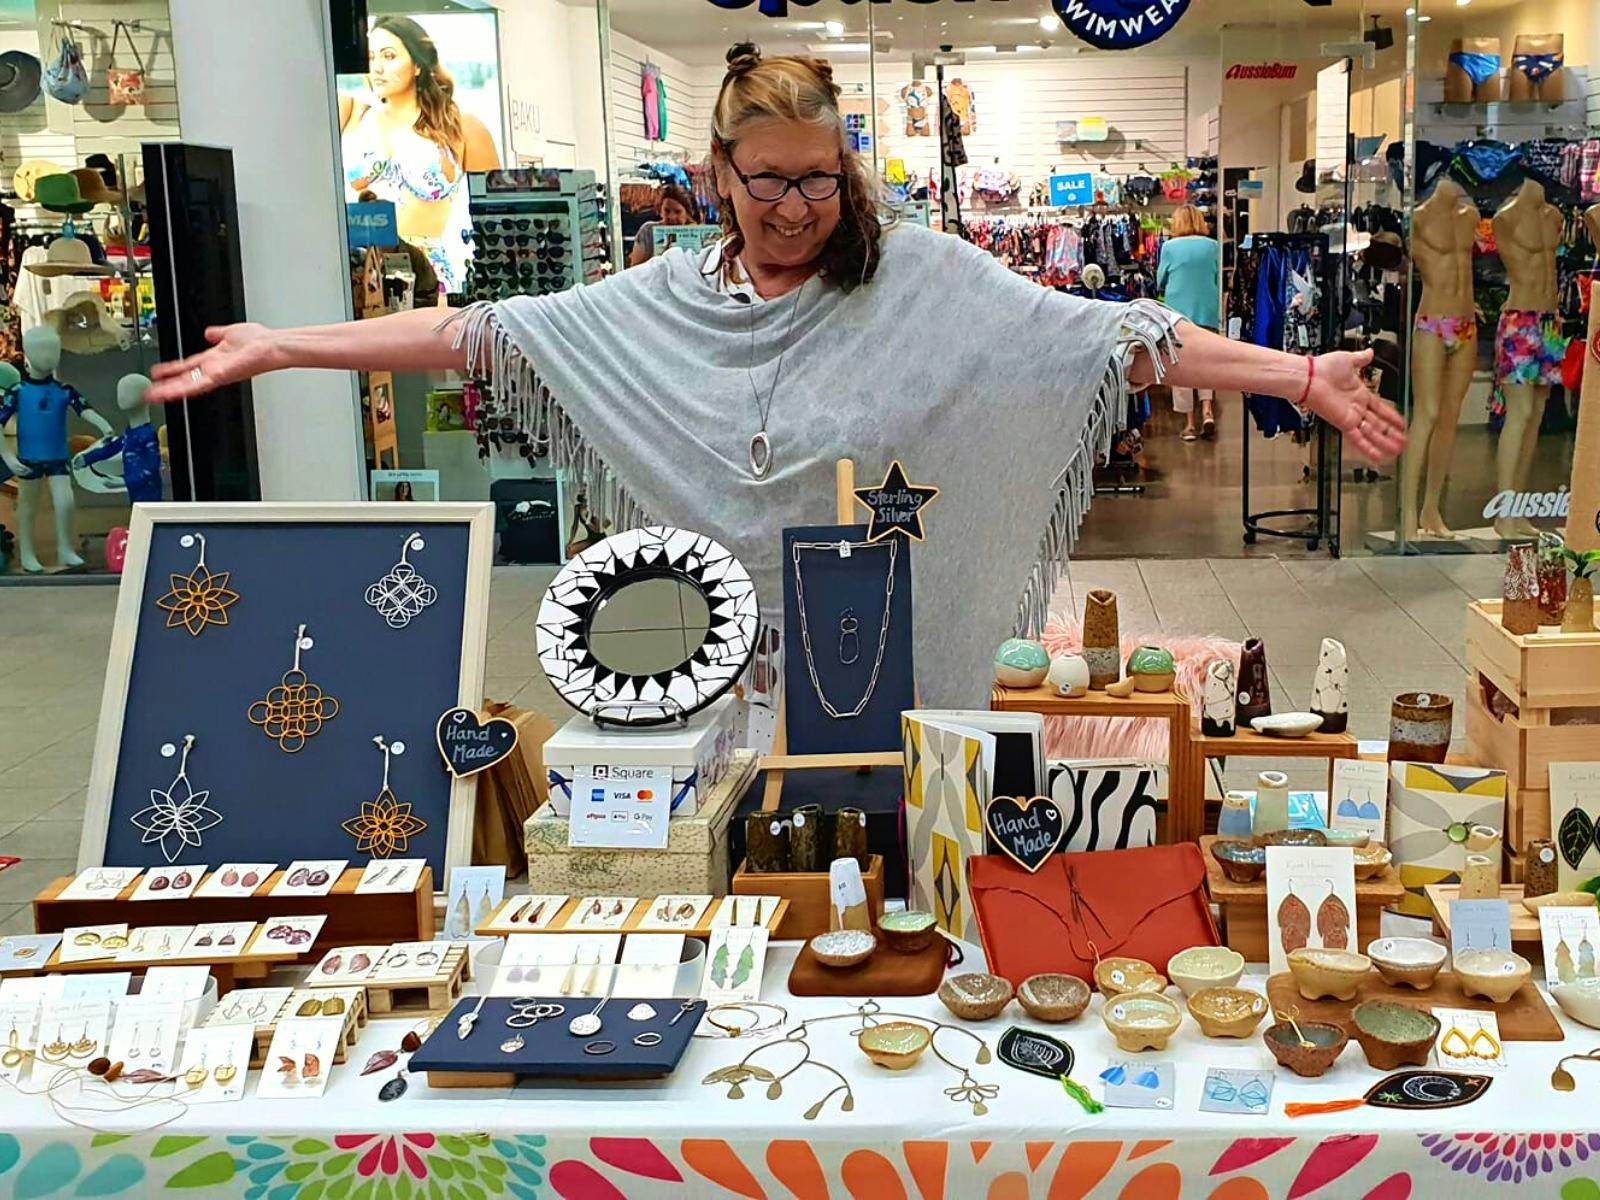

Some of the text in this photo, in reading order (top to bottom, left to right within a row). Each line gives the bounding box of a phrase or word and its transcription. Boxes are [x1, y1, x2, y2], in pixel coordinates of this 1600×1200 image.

[511, 98, 540, 134] BAKU
[1056, 179, 1086, 192] SALE
[867, 489, 923, 511] Sterling
[876, 507, 915, 523] Silver
[446, 725, 490, 741] Hand
[452, 744, 499, 763] Made
[612, 766, 654, 780] Square
[613, 792, 632, 800] VISA
[992, 806, 1041, 836] Hand
[1013, 830, 1056, 857] Made
